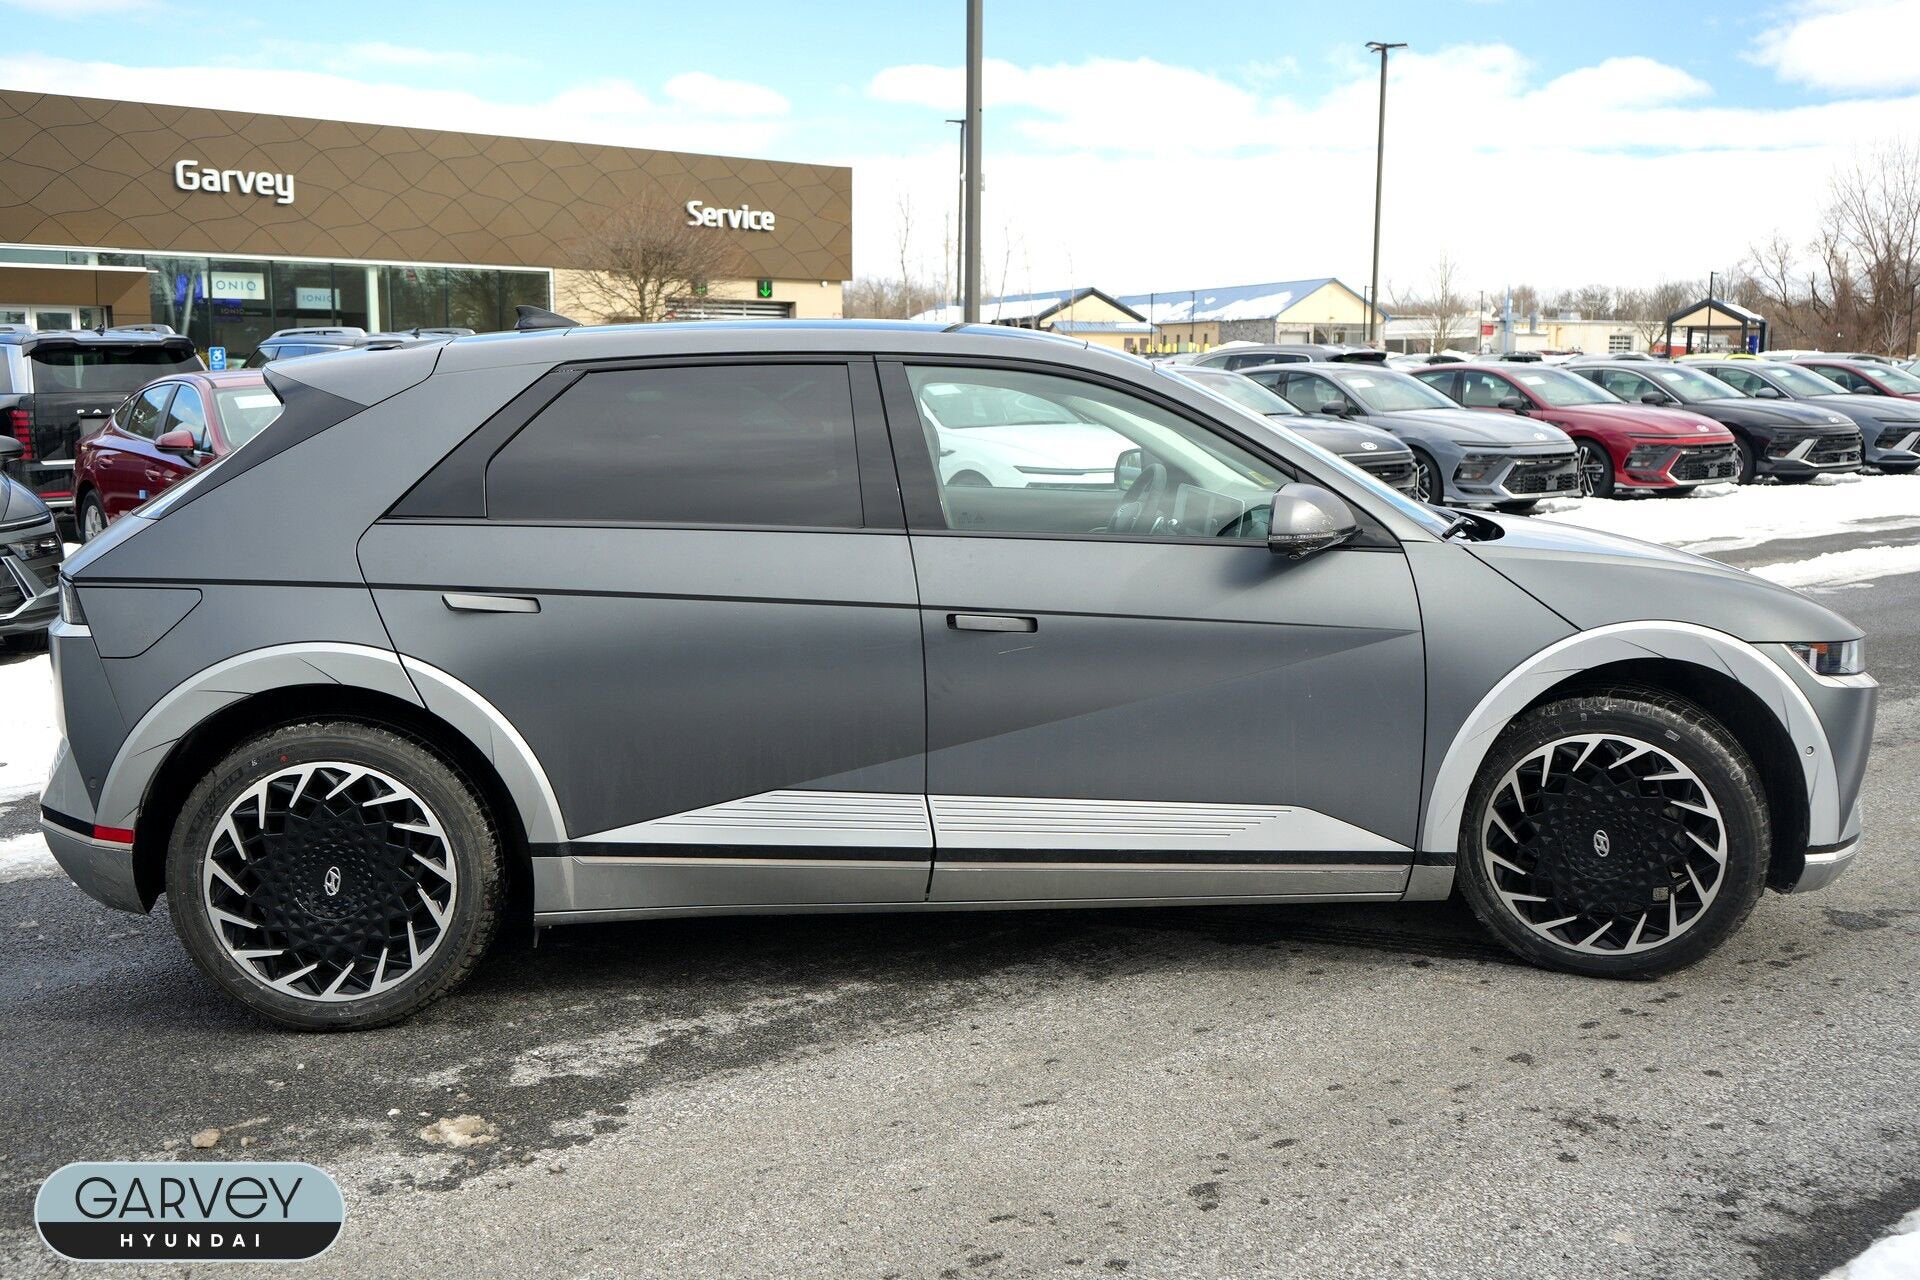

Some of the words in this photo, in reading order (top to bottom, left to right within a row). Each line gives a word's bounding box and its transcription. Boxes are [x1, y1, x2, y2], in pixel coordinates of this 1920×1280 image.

[175, 159, 295, 204] Garvey
[686, 200, 776, 231] Service
[215, 280, 257, 291] ONIQ
